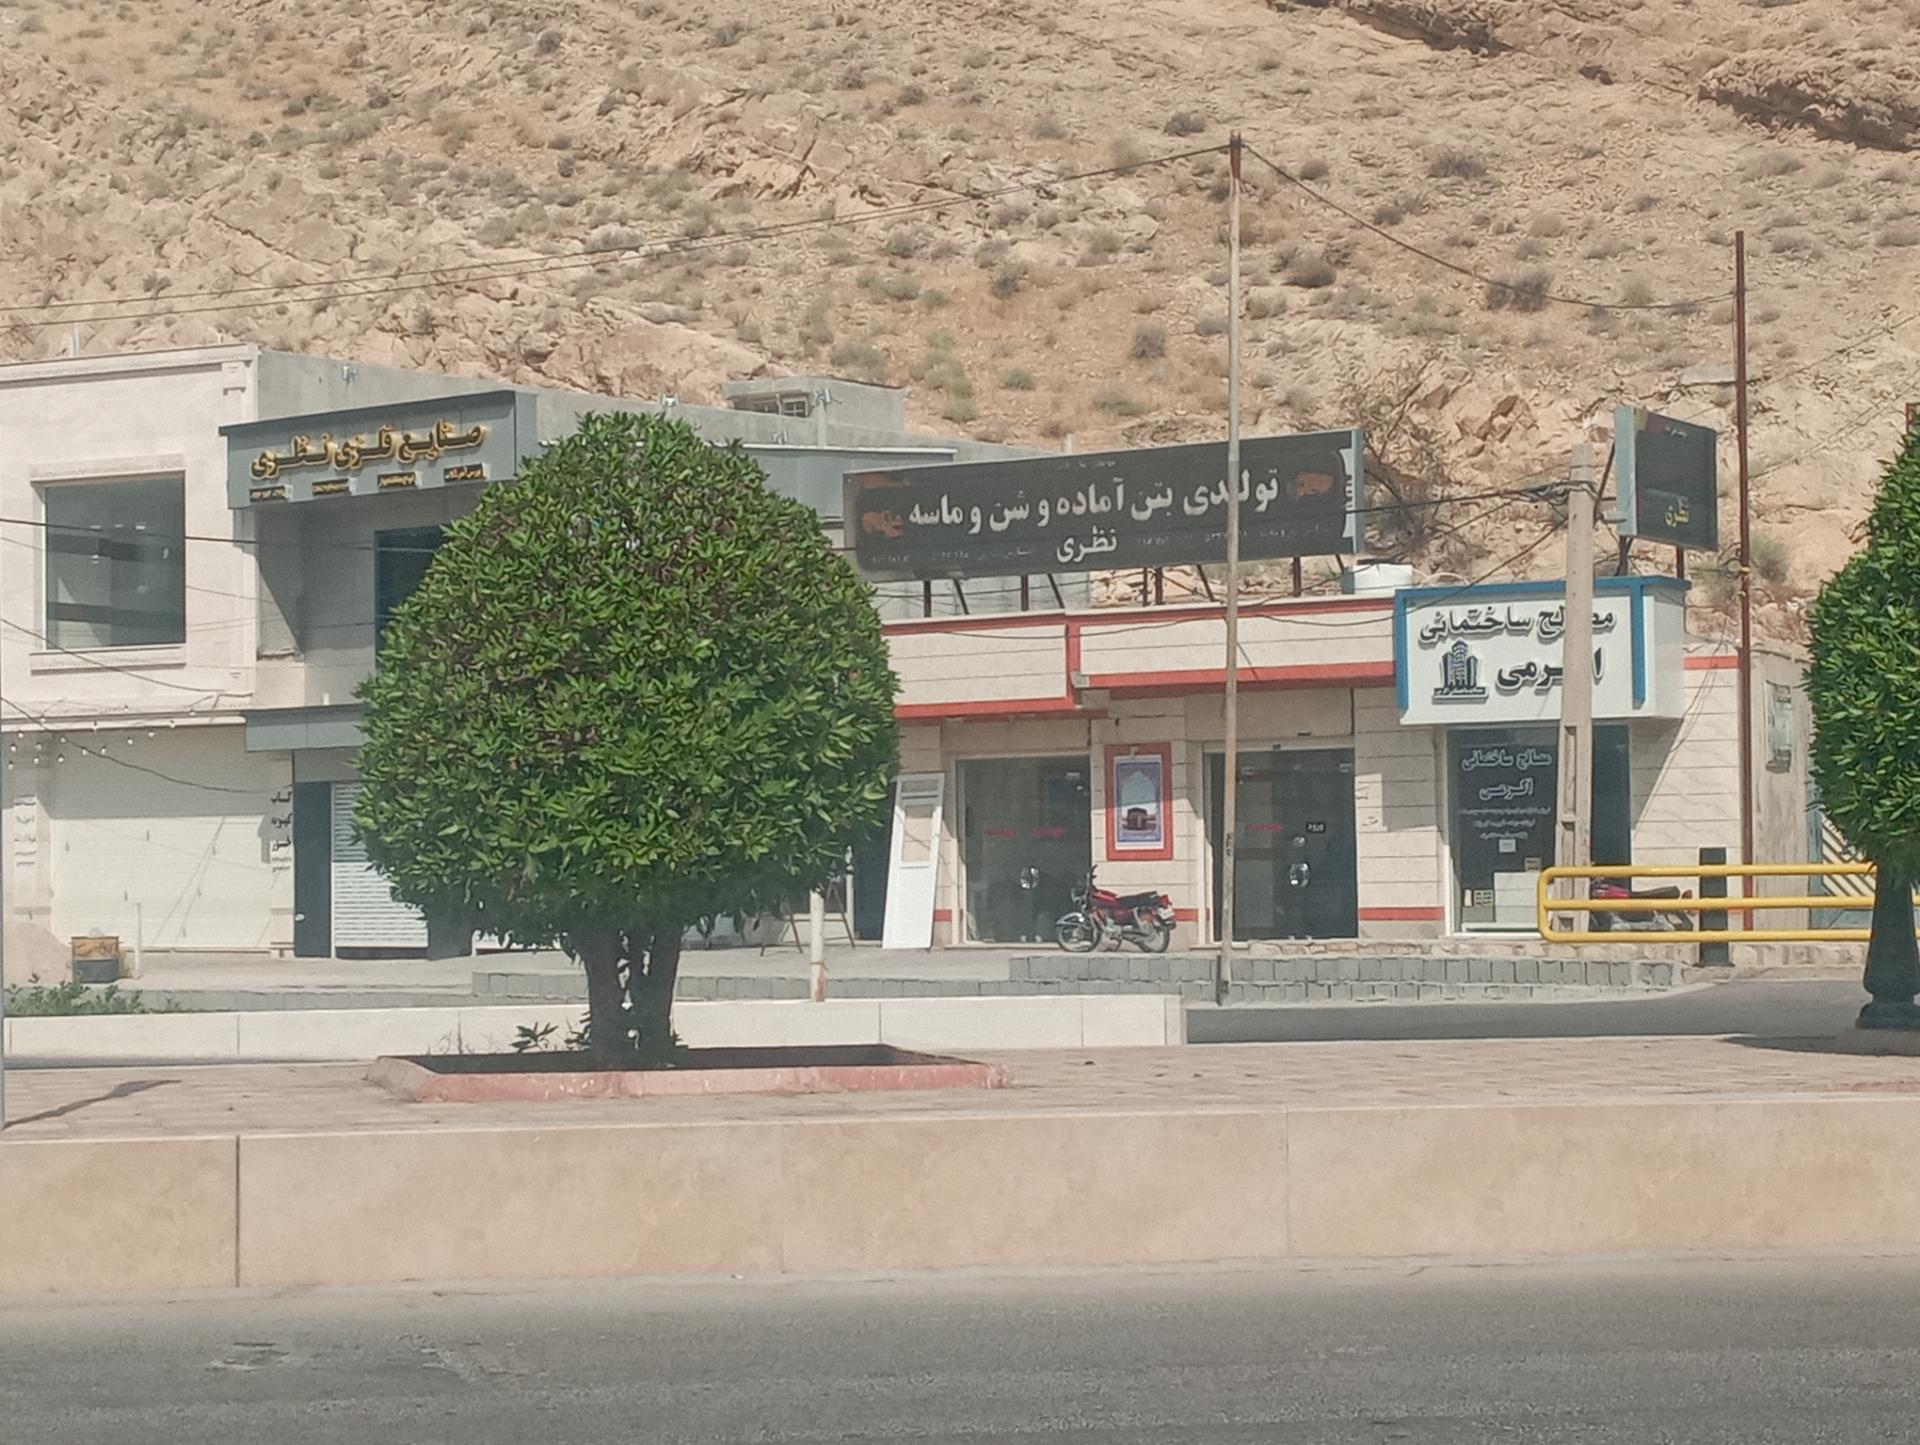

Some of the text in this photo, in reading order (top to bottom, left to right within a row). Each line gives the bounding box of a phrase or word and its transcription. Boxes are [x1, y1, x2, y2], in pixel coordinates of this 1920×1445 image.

[250, 419, 485, 480] صنایع فلزی نظری
[908, 468, 1279, 535] تولدی بتن آماده و شن و ماسه
[1056, 523, 1118, 564] نظری
[1420, 603, 1532, 641] ساختمانی
[1496, 646, 1602, 688] ارمی
[1479, 776, 1534, 801] اکرمی
